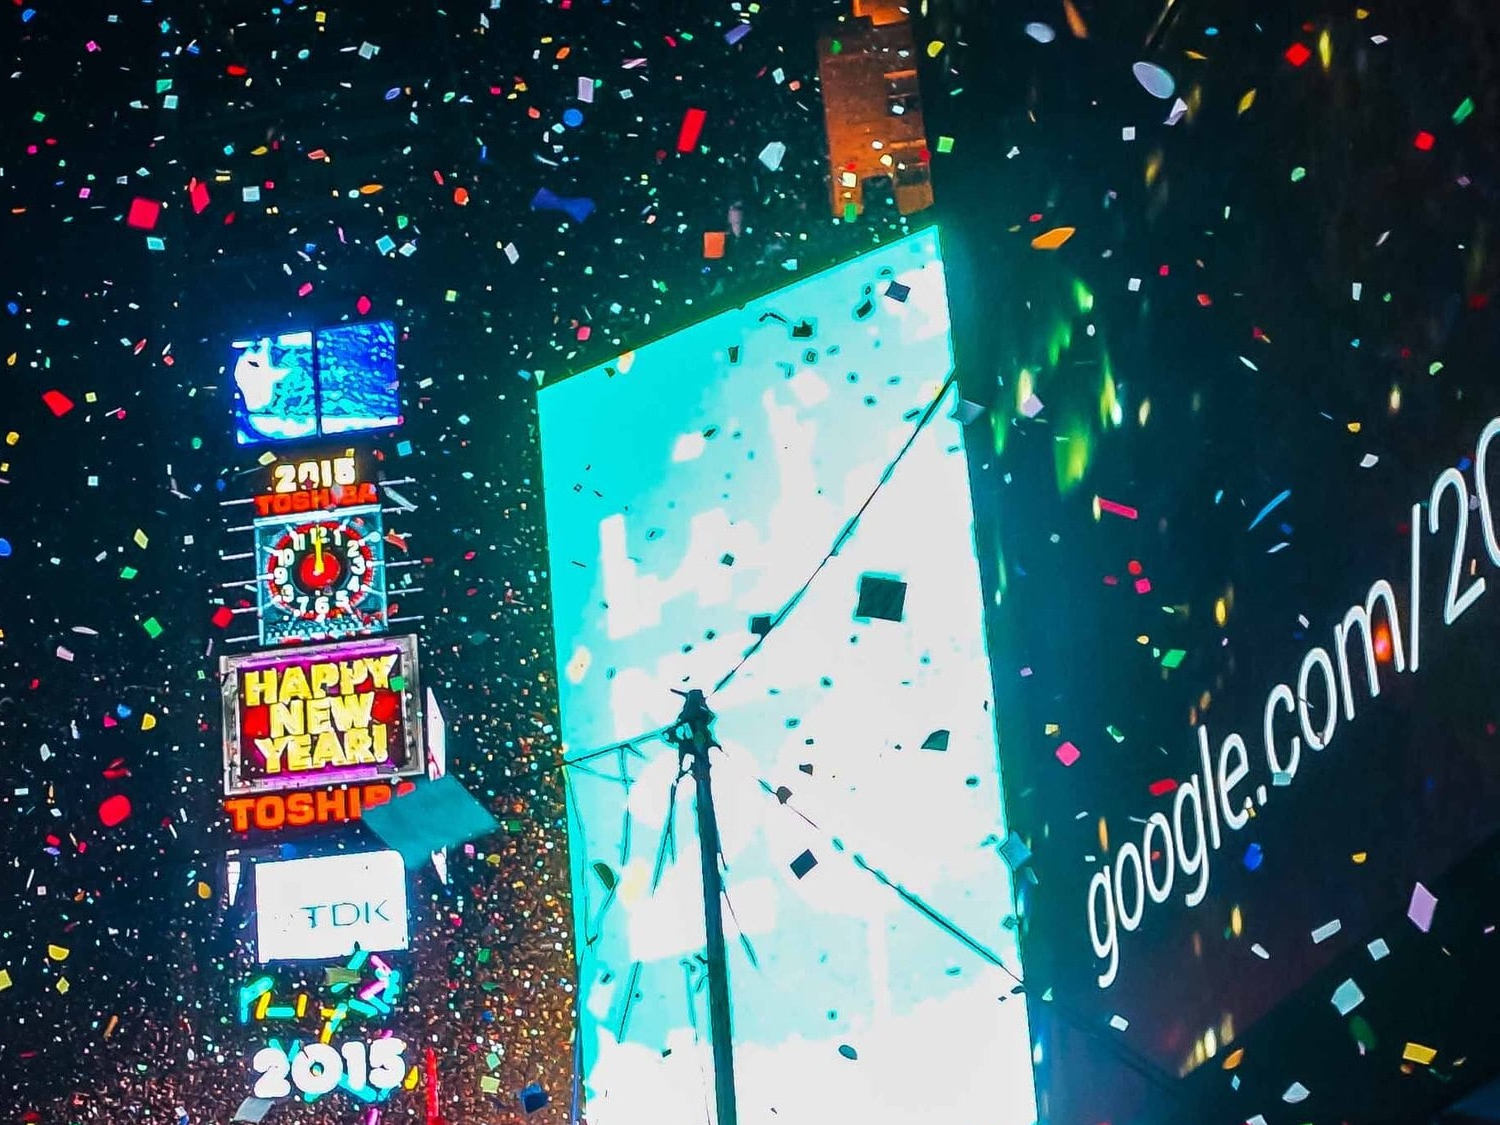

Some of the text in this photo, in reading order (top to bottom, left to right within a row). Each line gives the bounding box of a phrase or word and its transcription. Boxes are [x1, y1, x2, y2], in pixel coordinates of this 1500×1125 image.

[274, 457, 356, 493] 2015
[244, 654, 398, 707] HAPPY
[269, 691, 375, 739] NEW
[255, 724, 389, 774] YEAR!
[226, 784, 393, 833] TOSHIB
[301, 899, 391, 928] TDK
[253, 1038, 407, 1098] 2015
